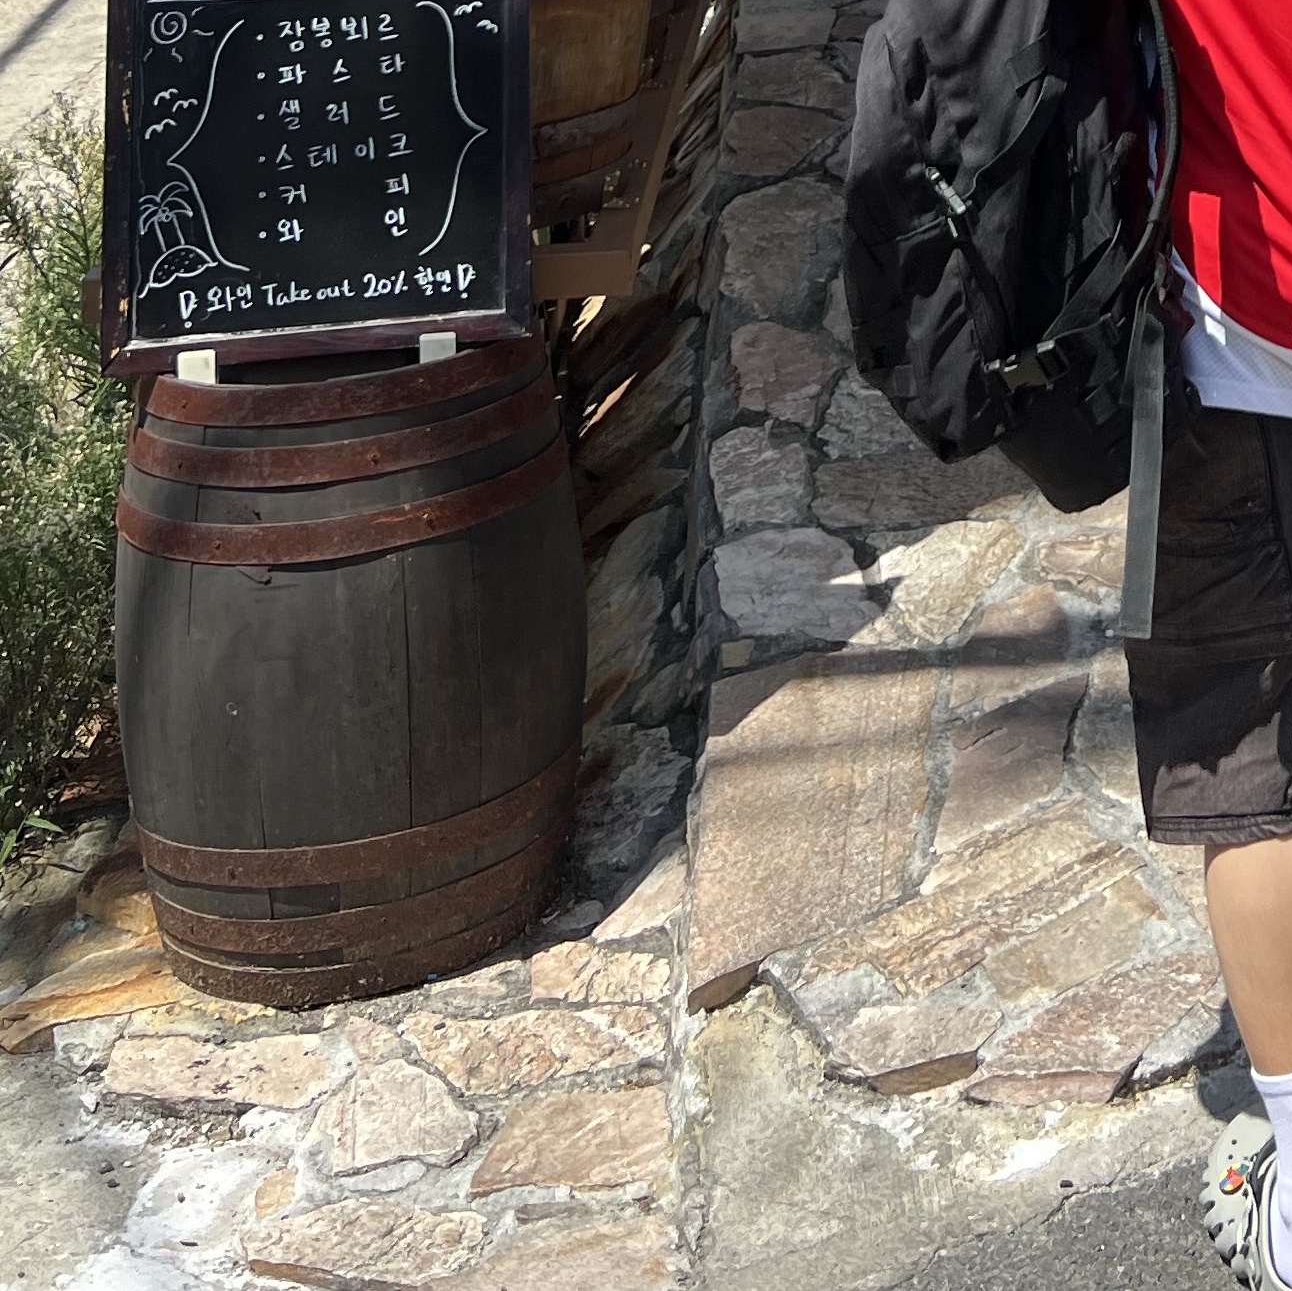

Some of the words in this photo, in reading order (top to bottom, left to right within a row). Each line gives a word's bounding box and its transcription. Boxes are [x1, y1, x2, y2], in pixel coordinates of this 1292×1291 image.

[206, 283, 254, 313] 와인
[260, 281, 312, 307] Take
[316, 278, 356, 301] out
[363, 270, 408, 299] 20%
